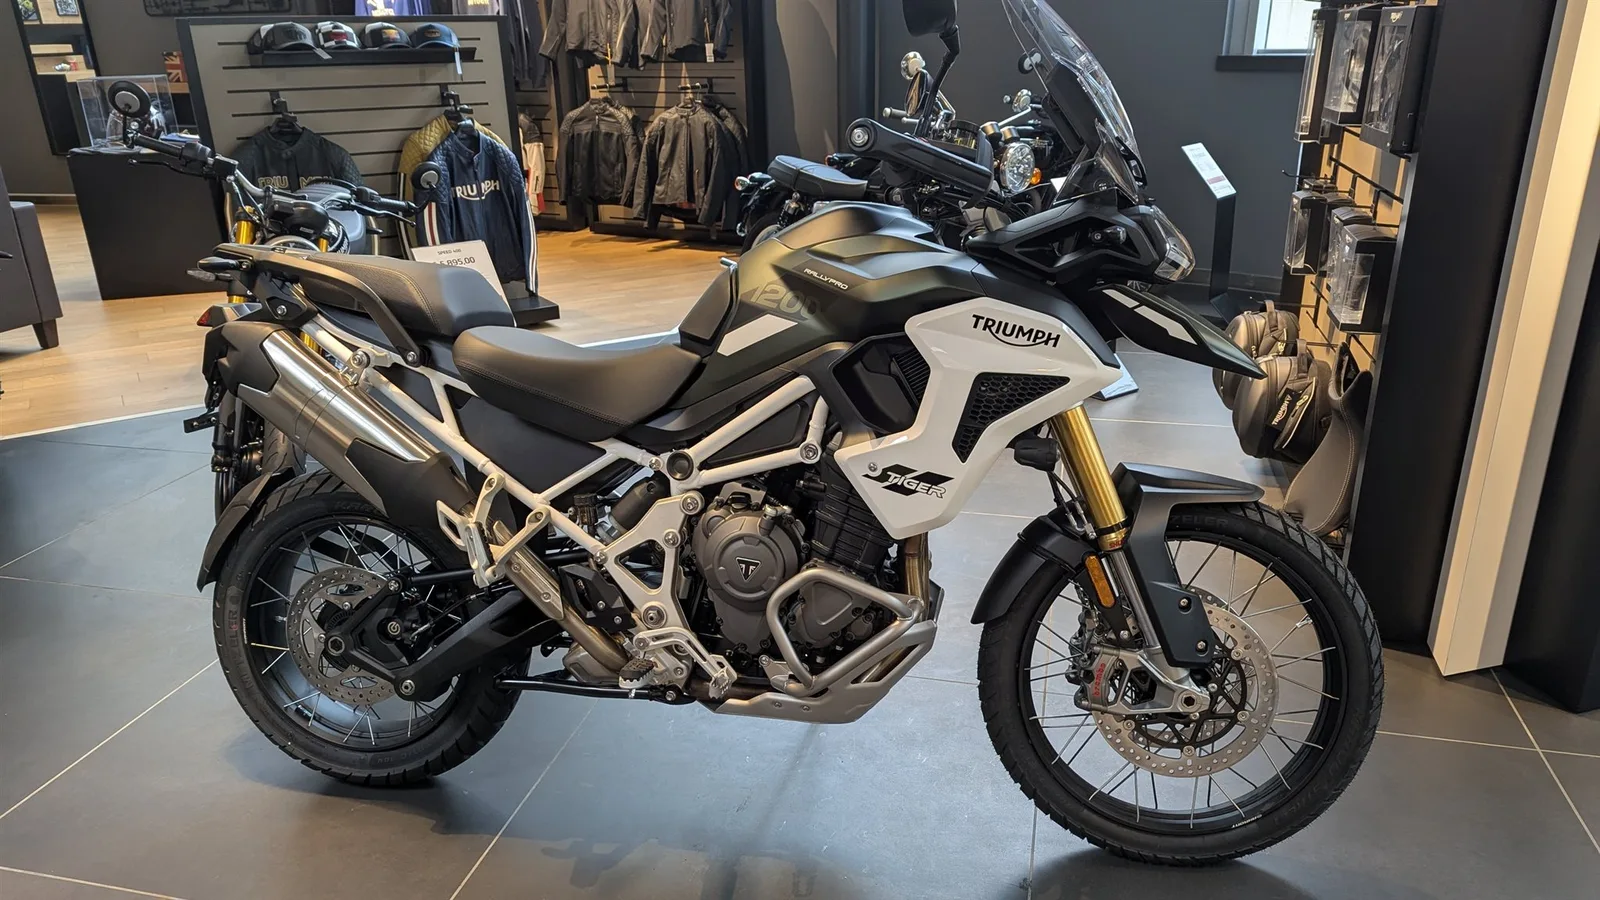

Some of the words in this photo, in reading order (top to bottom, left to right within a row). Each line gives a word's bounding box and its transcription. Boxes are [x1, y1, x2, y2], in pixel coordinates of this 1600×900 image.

[750, 282, 822, 319] 1200
[972, 314, 1061, 347] TRIUMPH
[1271, 399, 1290, 425] TRIUMPH
[886, 471, 947, 499] TIGER
